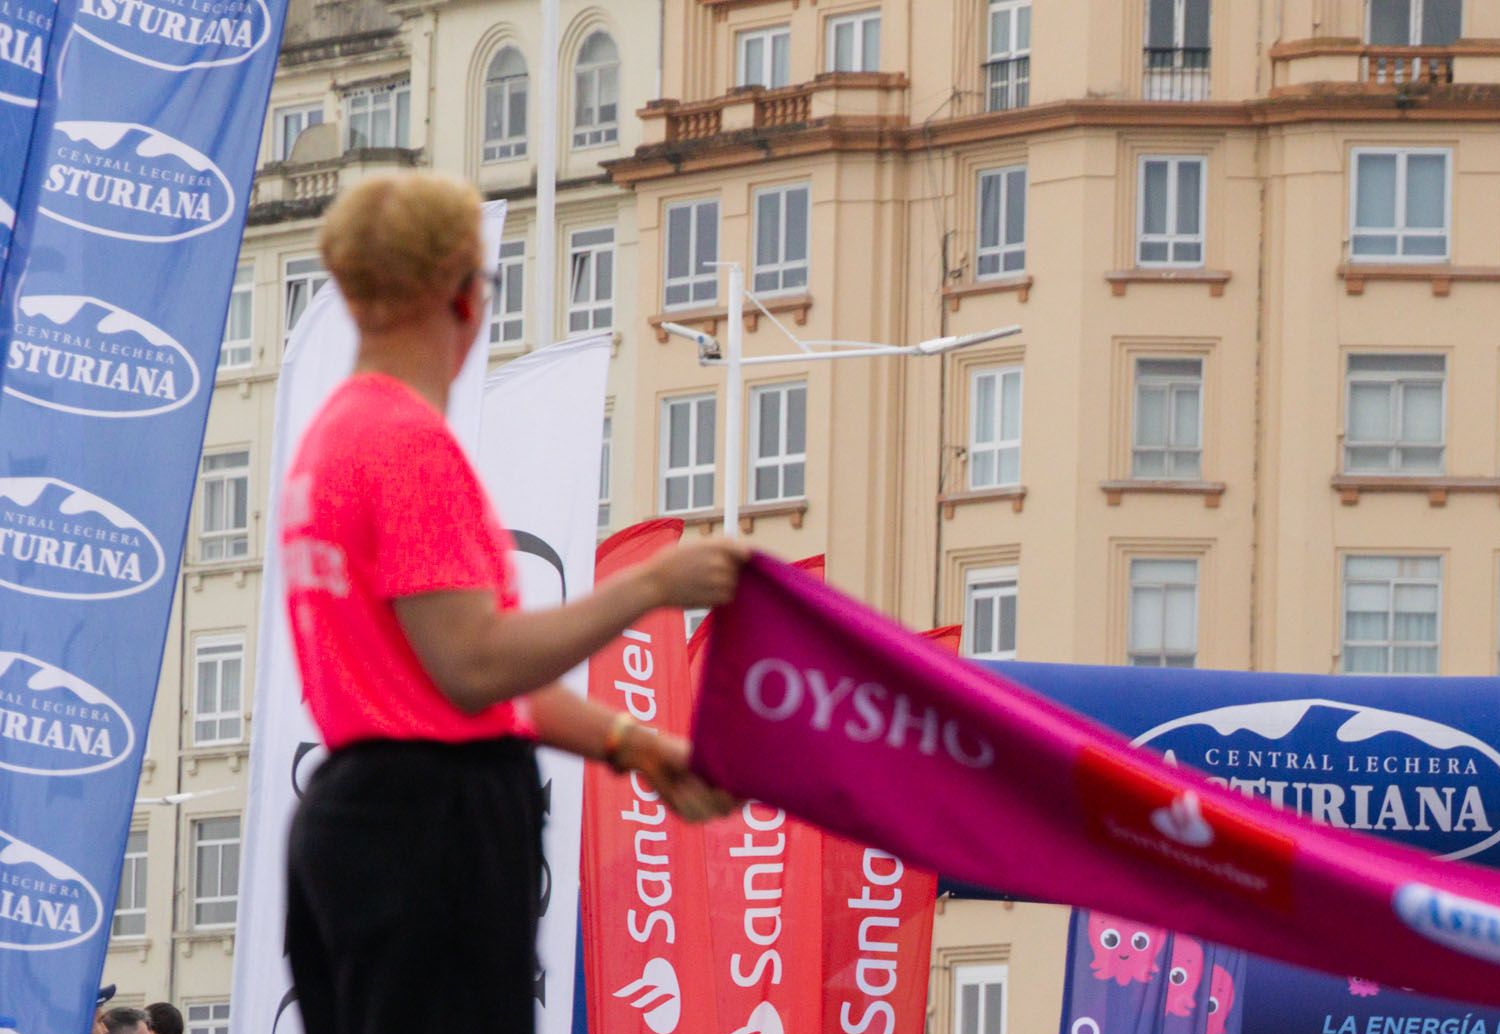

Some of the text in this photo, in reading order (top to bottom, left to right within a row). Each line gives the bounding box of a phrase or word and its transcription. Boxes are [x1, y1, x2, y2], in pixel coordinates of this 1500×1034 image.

[79, 0, 251, 48] STURIANA
[58, 146, 213, 187] CENTRAL LECHERA
[14, 323, 176, 365] CENTRAL LECHERA
[63, 521, 141, 547] LECHERA
[32, 694, 111, 722] LECHERA
[1205, 748, 1479, 775] CENTRAL LECHERA
[1163, 750, 1493, 833] TURIANA
[2, 875, 80, 899] LECHERA
